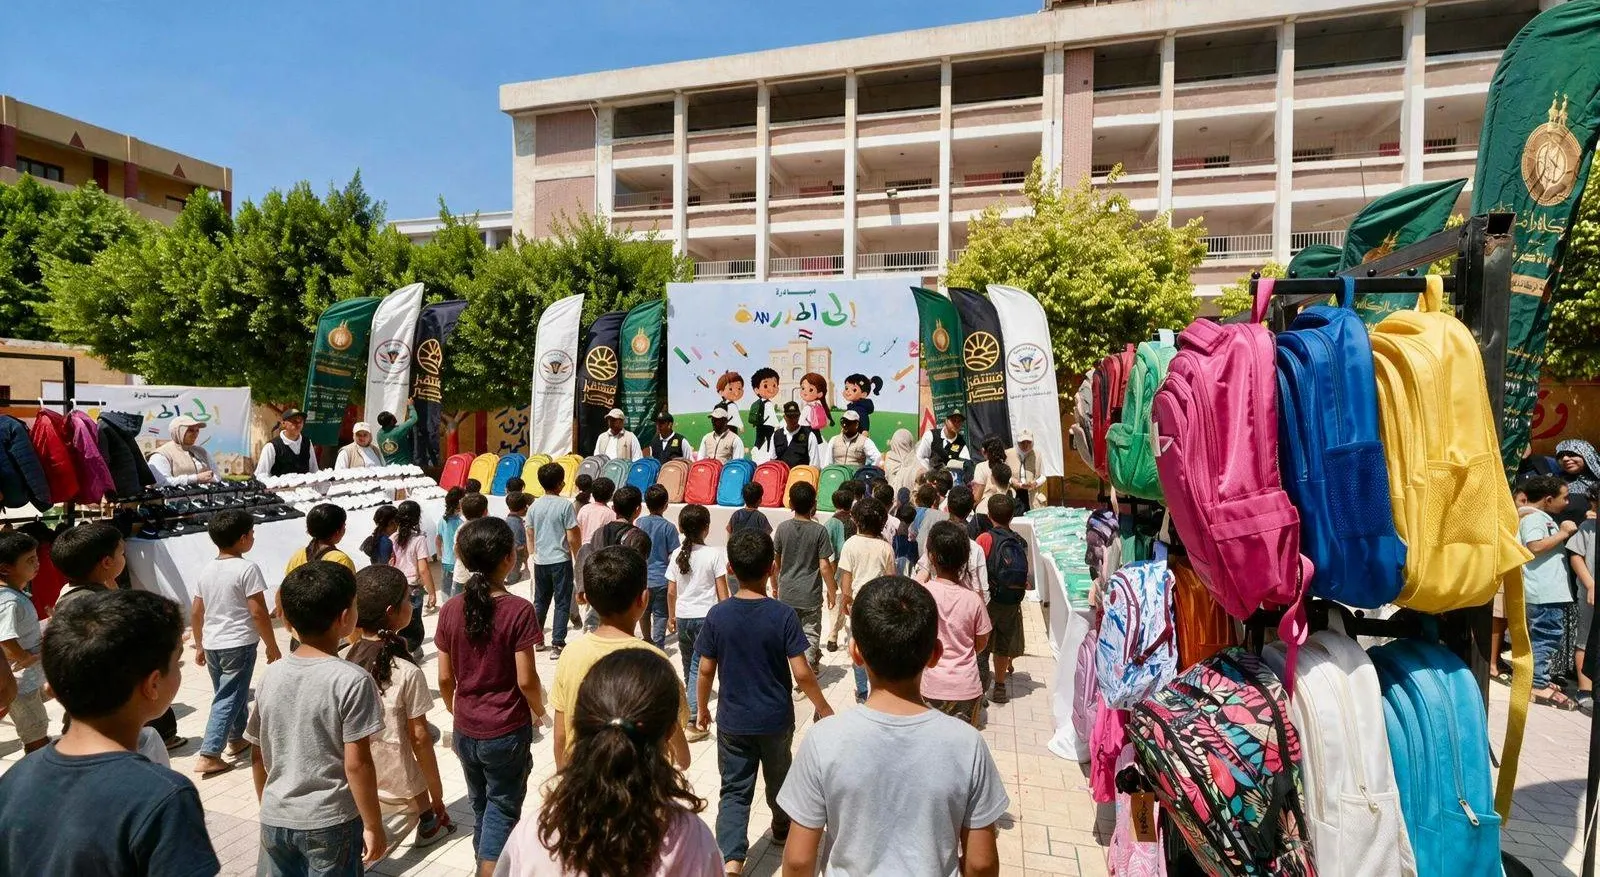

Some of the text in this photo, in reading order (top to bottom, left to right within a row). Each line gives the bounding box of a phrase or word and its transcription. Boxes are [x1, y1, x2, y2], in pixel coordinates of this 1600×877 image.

[775, 288, 816, 297] مبادرة
[734, 292, 857, 328] إلى المدرسة
